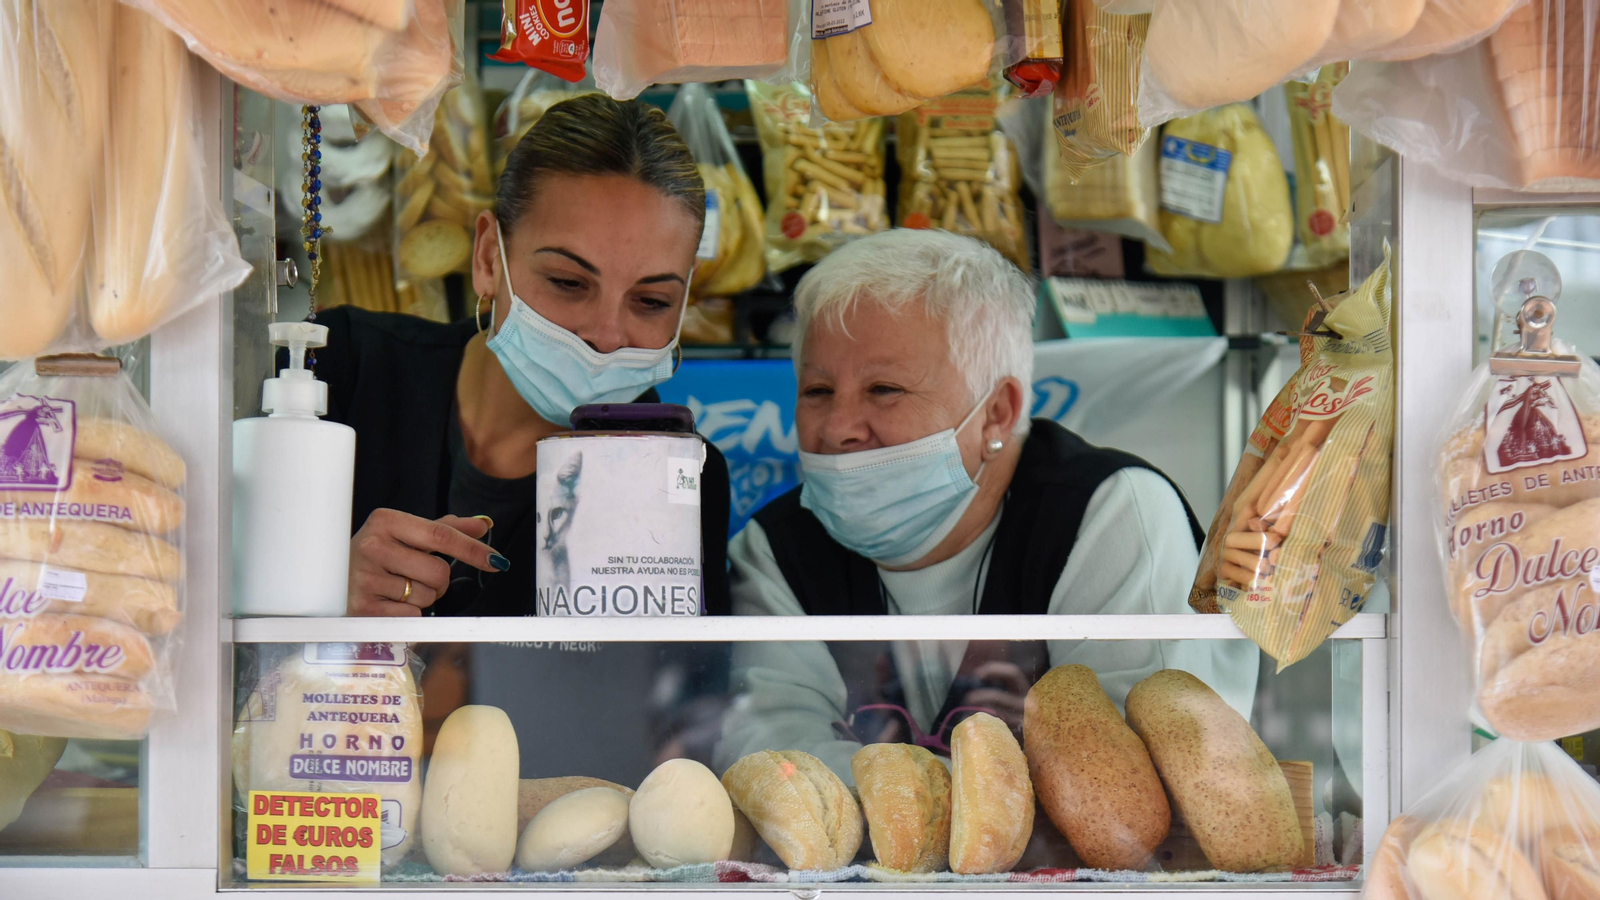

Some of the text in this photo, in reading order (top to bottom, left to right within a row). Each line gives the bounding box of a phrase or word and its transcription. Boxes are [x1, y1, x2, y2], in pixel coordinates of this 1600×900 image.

[519, 13, 542, 46] MINI
[528, 5, 550, 40] COOKIES
[1524, 473, 1550, 490] DE
[0, 501, 133, 520] E ANTEQUERA
[591, 566, 635, 575] NUESTRA
[636, 567, 666, 575] AYUDA
[679, 567, 687, 576] ES
[607, 556, 695, 566] SIN TU COLABORACIÓN
[1475, 538, 1599, 598] Dulce
[537, 585, 697, 616] NACIONES
[1528, 582, 1600, 644] No
[302, 693, 402, 706] MOLLETES DE
[307, 711, 400, 724] ANTEQUERA
[300, 733, 405, 751] HORNO
[293, 758, 341, 775] DULCE
[345, 759, 409, 778] NOMBRE
[253, 794, 379, 819] DETECTOR
[256, 823, 374, 849] DE €UROS
[268, 853, 361, 877] FALSOS
